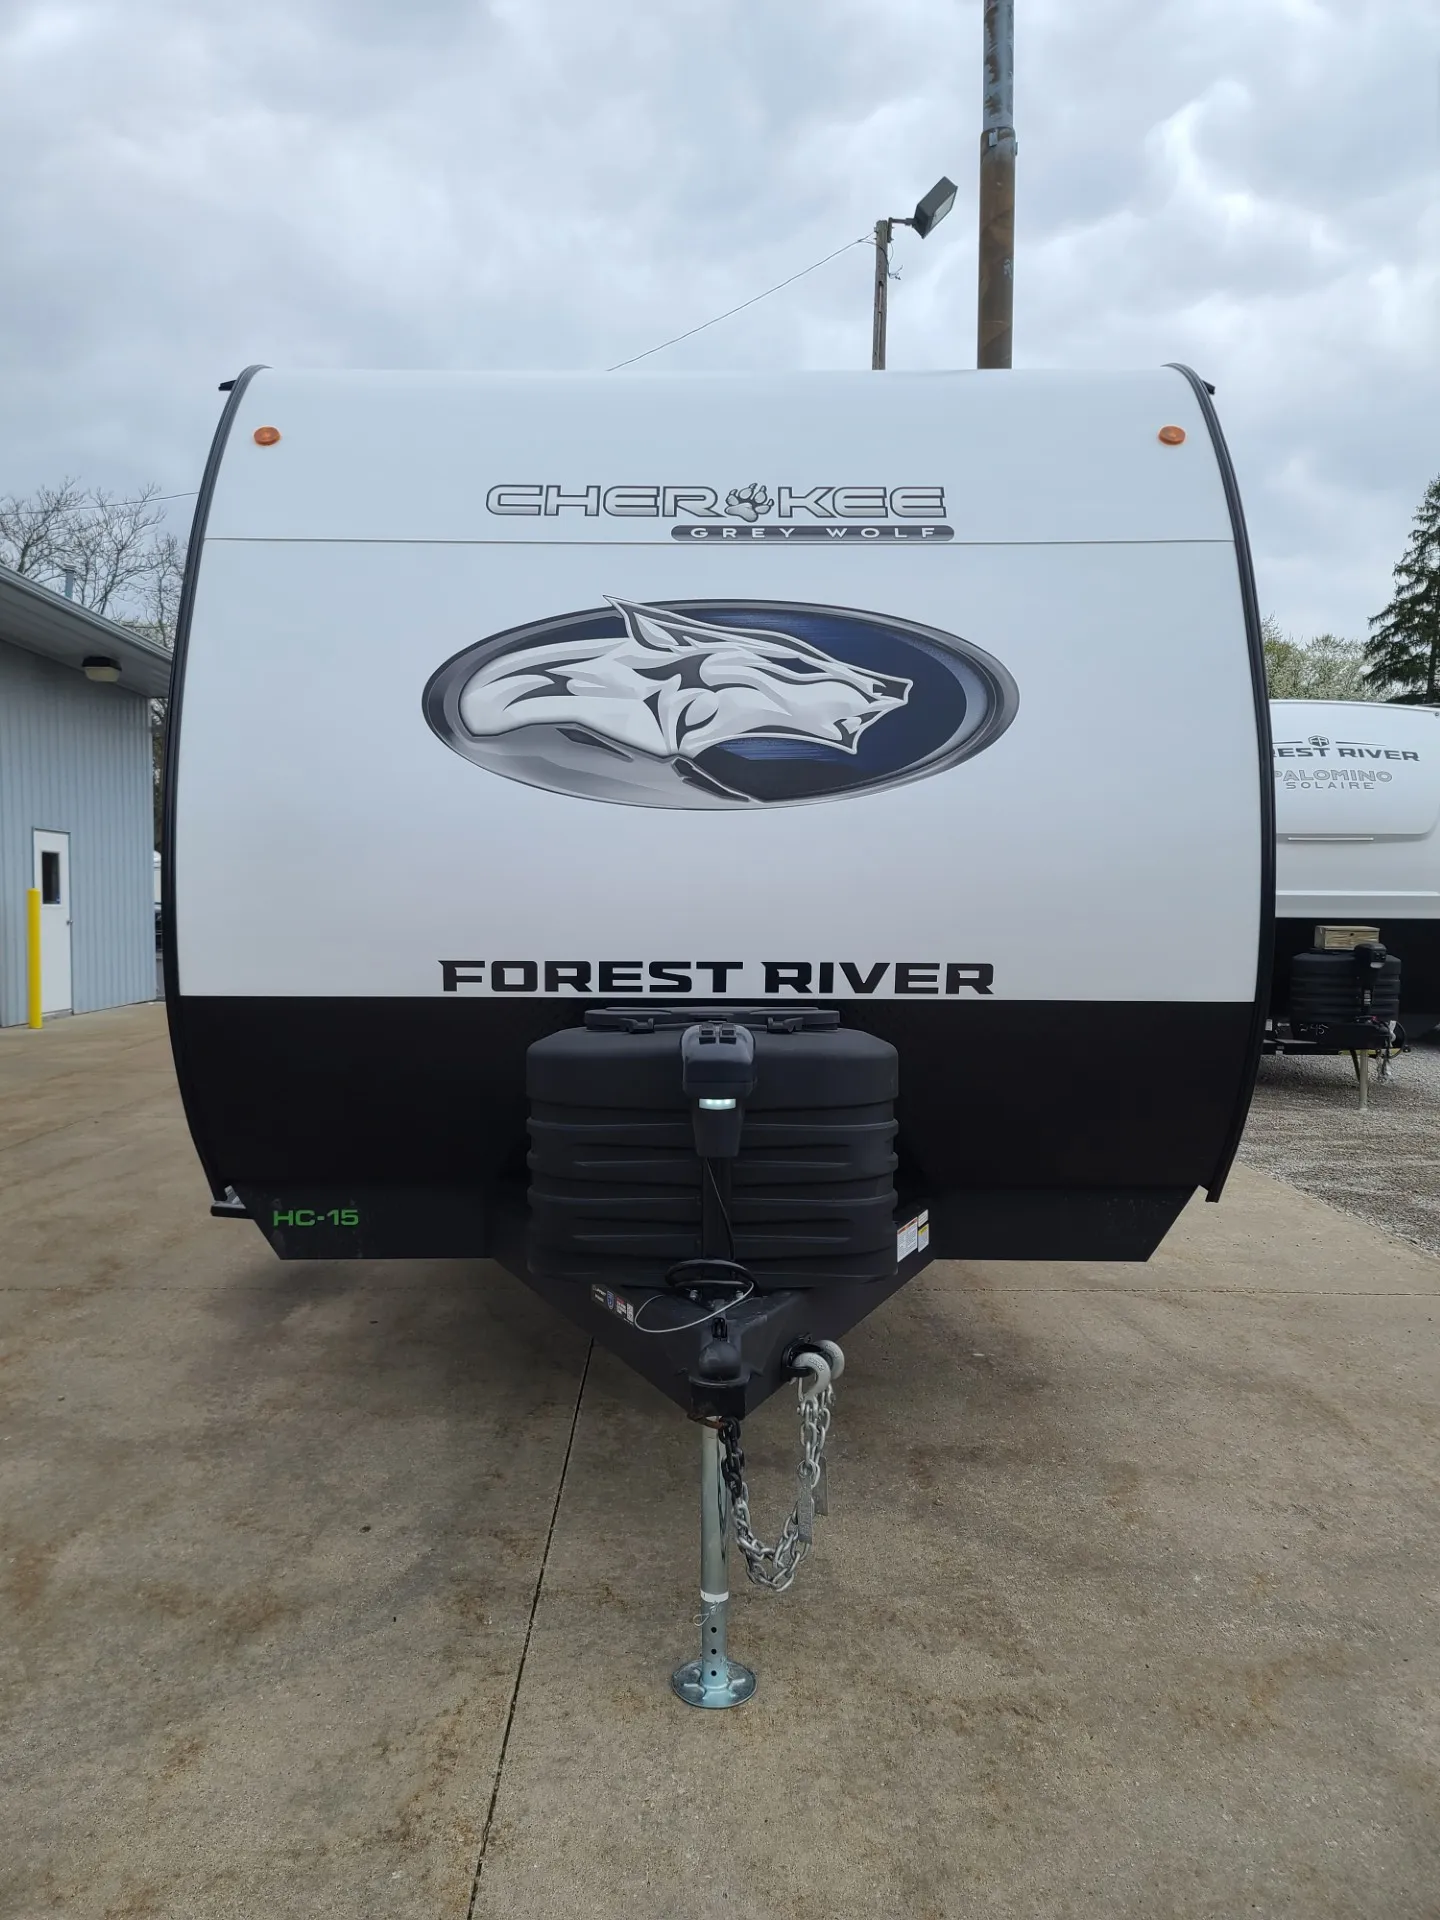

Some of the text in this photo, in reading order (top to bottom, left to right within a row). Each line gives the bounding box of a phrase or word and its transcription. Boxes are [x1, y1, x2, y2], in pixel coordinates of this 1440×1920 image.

[690, 527, 935, 538] GREY WOLF
[1273, 747, 1420, 761] EST RIVER
[1286, 781, 1374, 789] SOLAIRE
[437, 960, 994, 995] FOREST RIVER
[273, 1209, 360, 1226] HC-15
